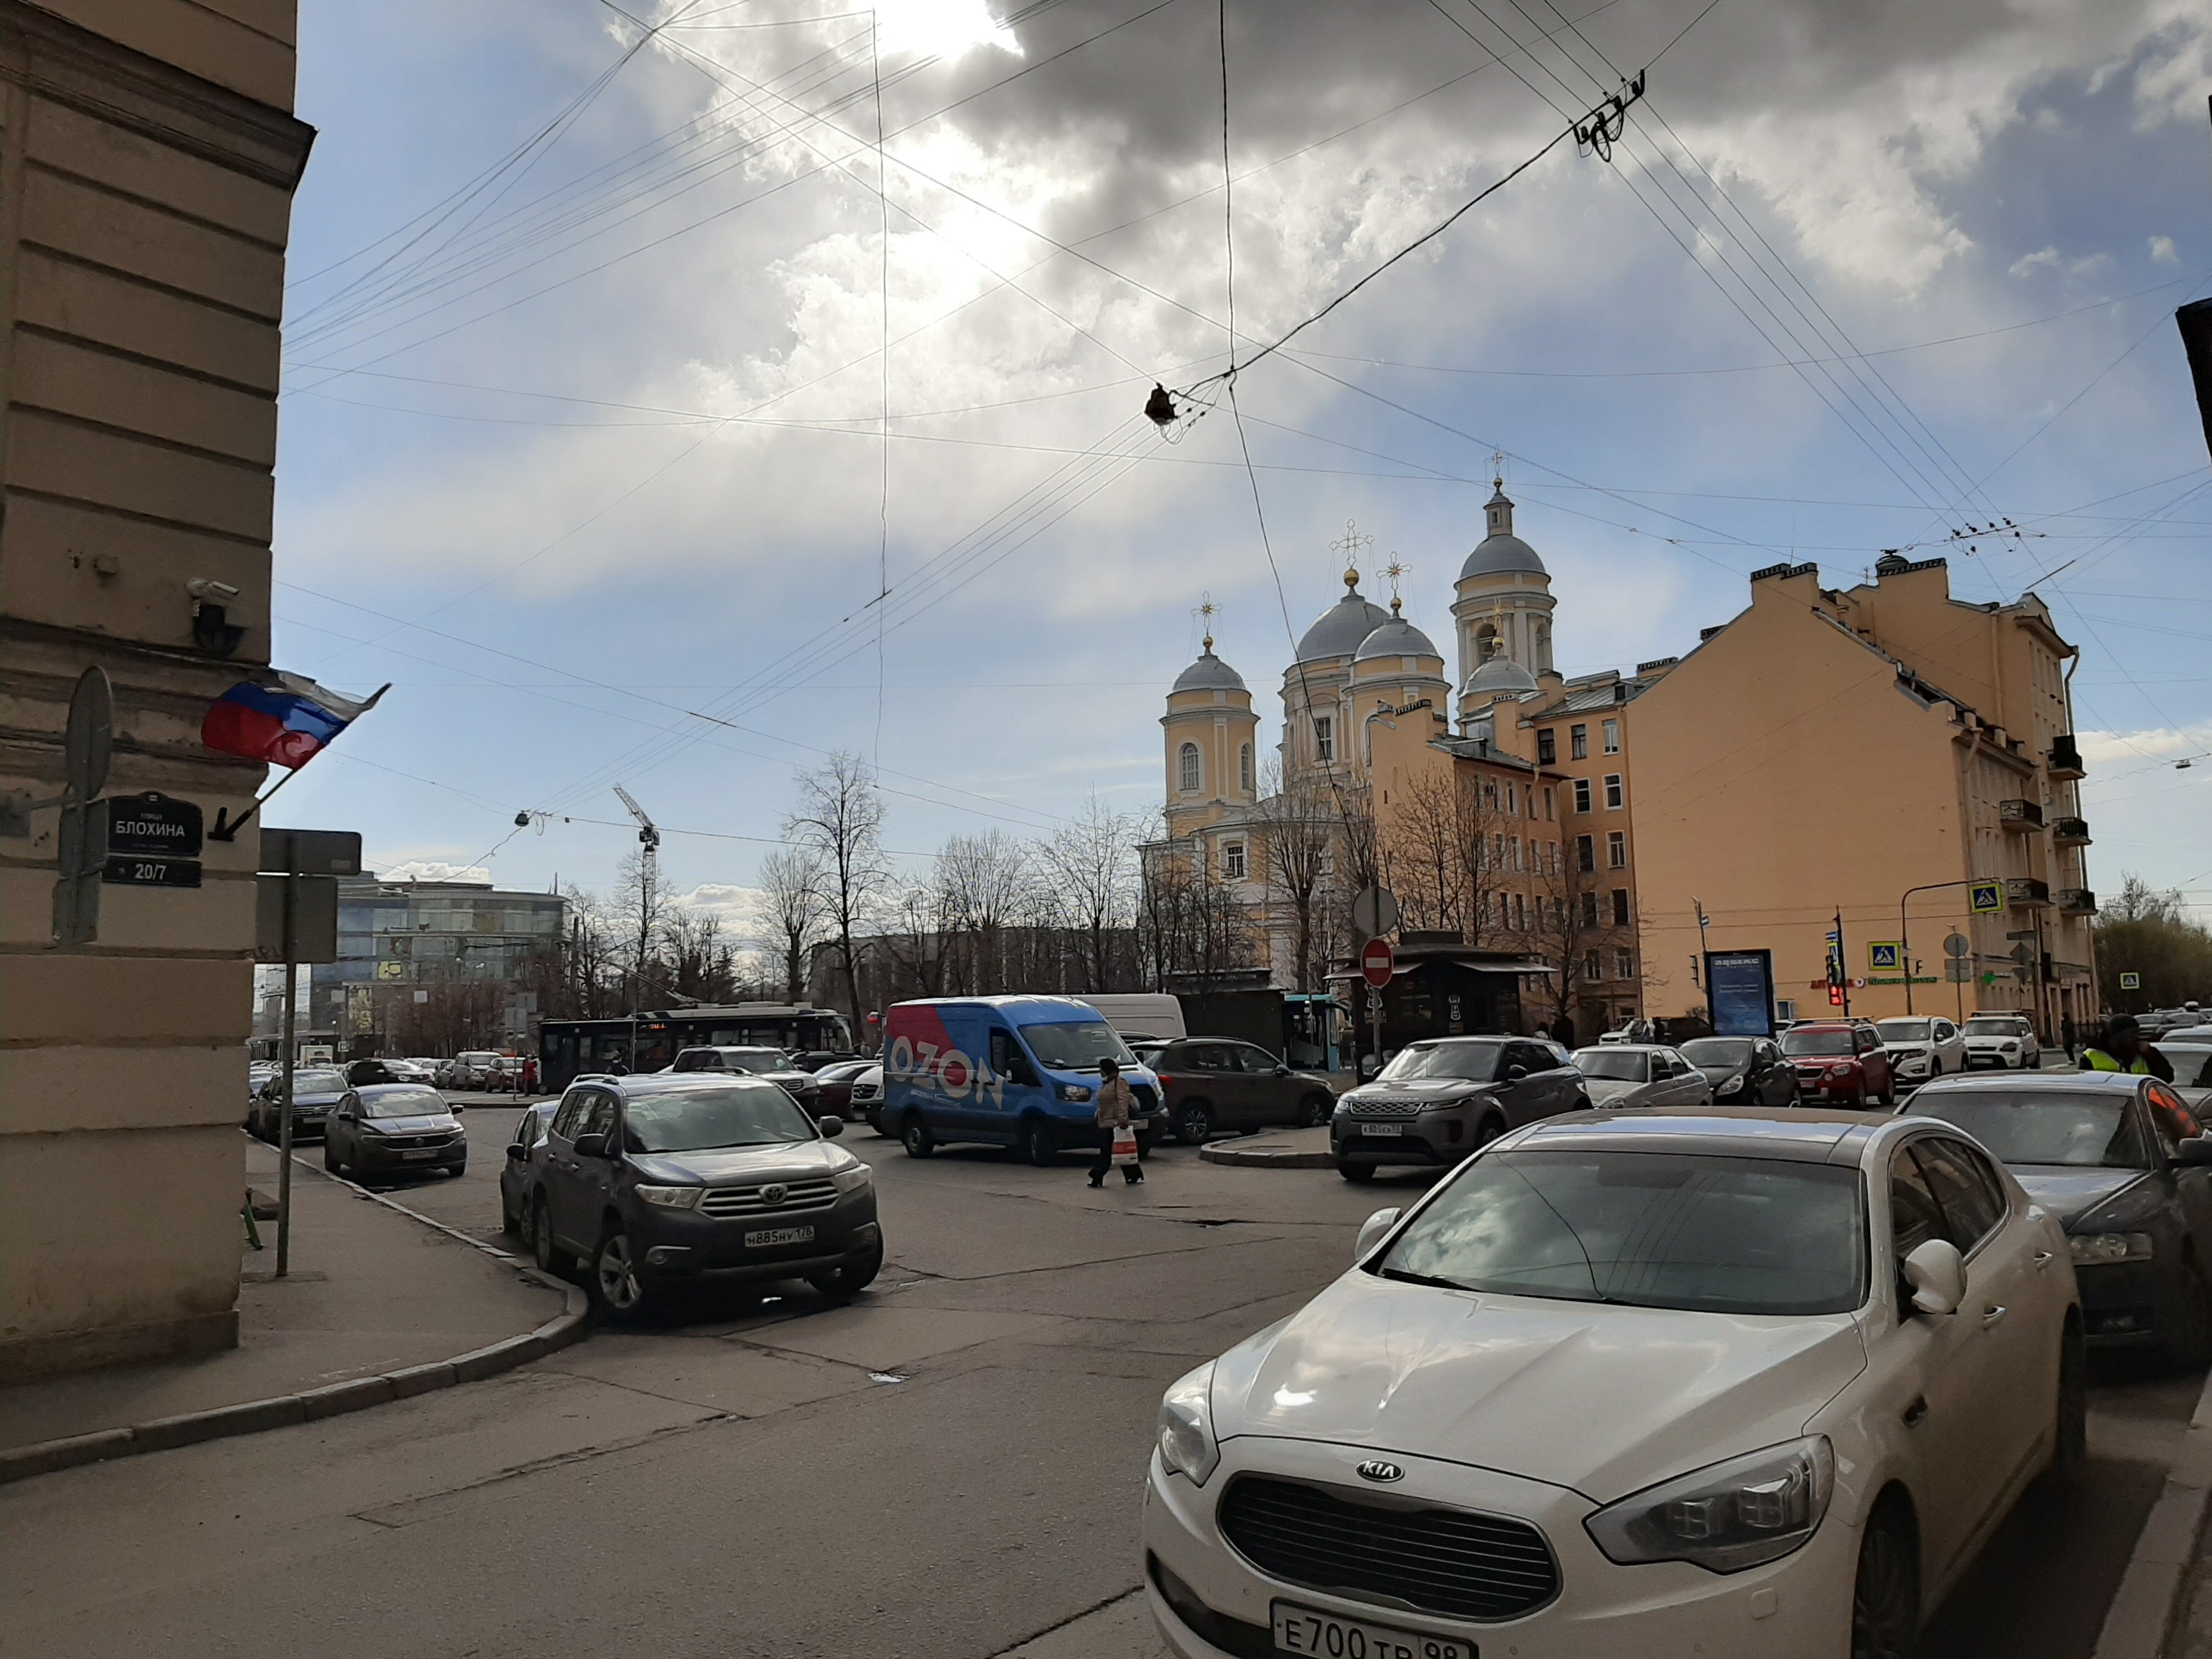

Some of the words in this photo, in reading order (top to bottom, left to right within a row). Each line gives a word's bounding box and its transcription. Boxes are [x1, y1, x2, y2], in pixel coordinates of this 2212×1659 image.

[115, 820, 185, 837] БЛОХИНА
[135, 864, 167, 880] 20/7
[890, 1032, 1004, 1110] OZON
[1362, 1460, 1394, 1477] KIA
